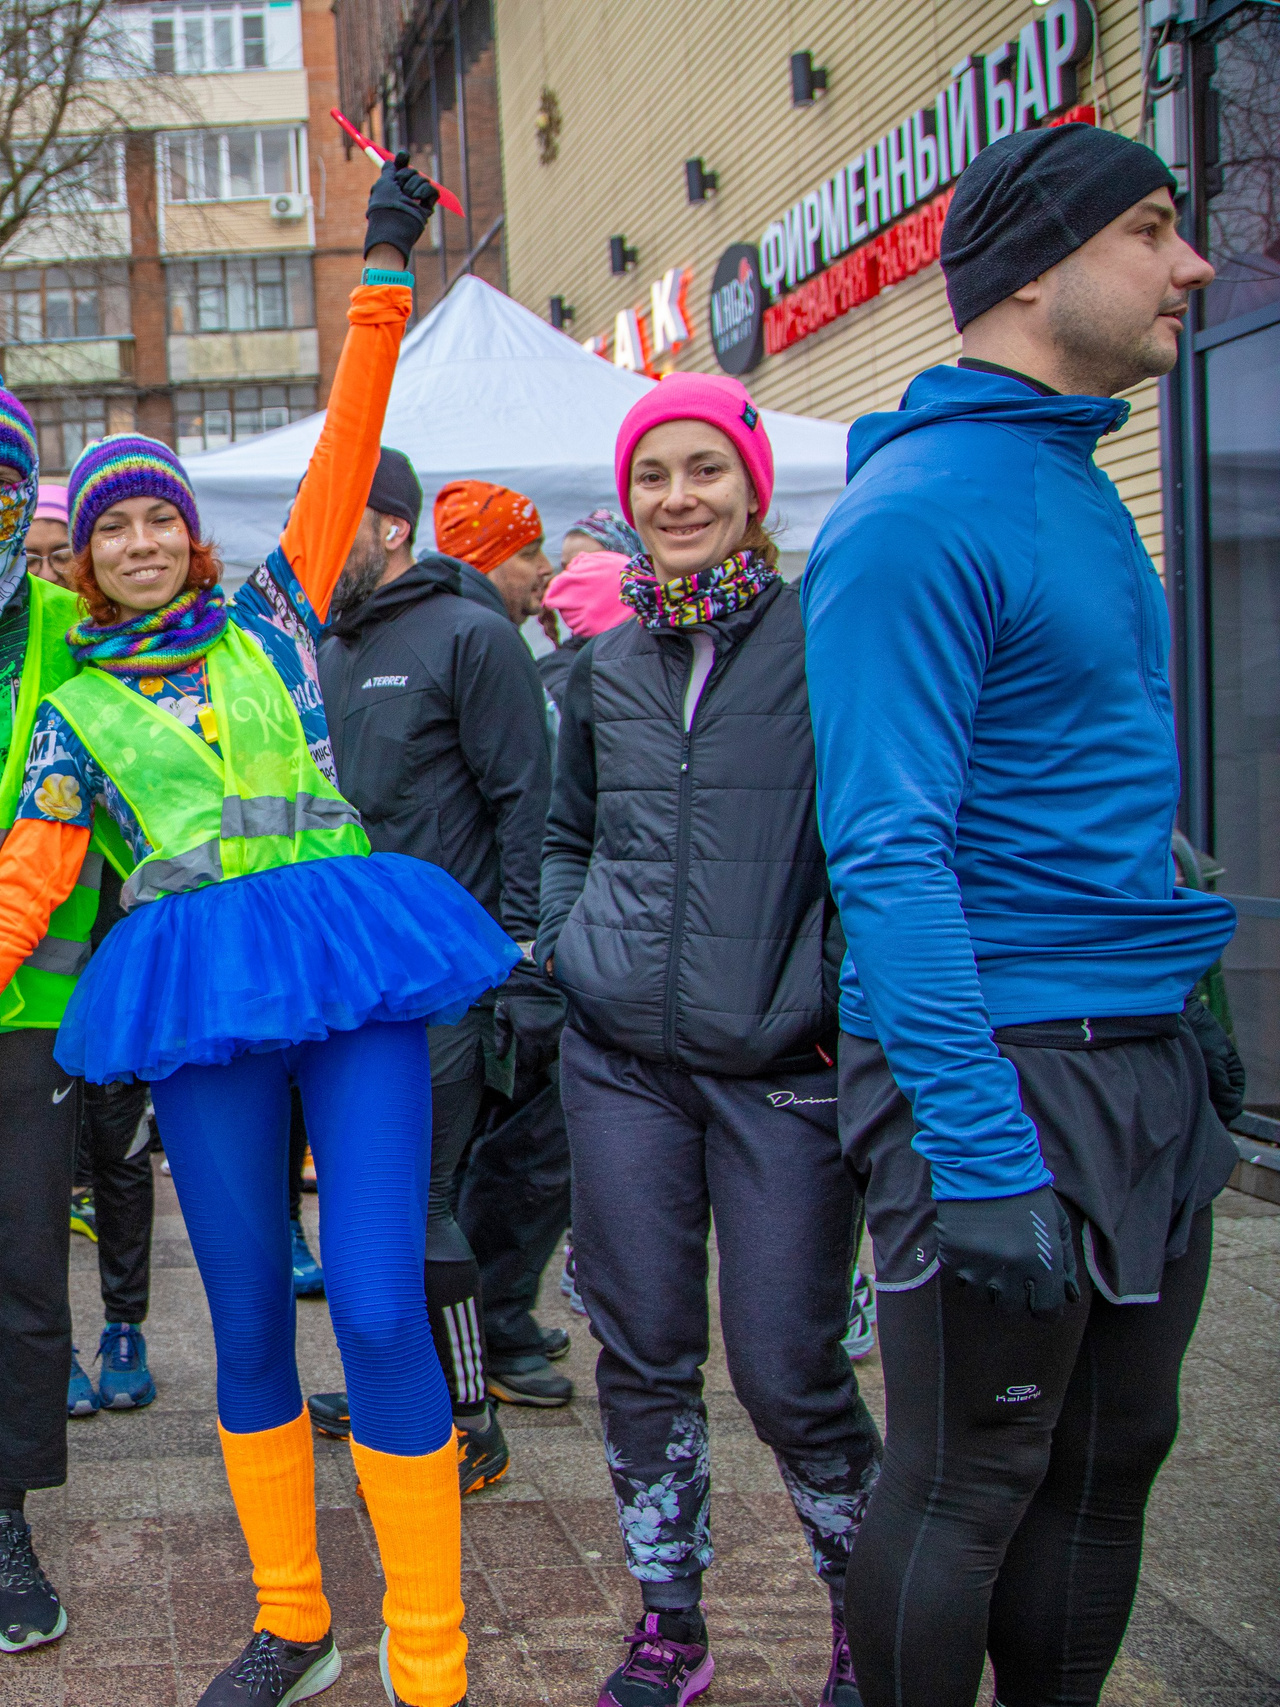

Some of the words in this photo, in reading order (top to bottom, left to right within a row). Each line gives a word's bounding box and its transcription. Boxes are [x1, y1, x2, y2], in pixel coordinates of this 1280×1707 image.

[759, 55, 979, 298] ФИРМЕННЫЙ
[984, 0, 1080, 146] БАР
[372, 675, 409, 688] TERREX
